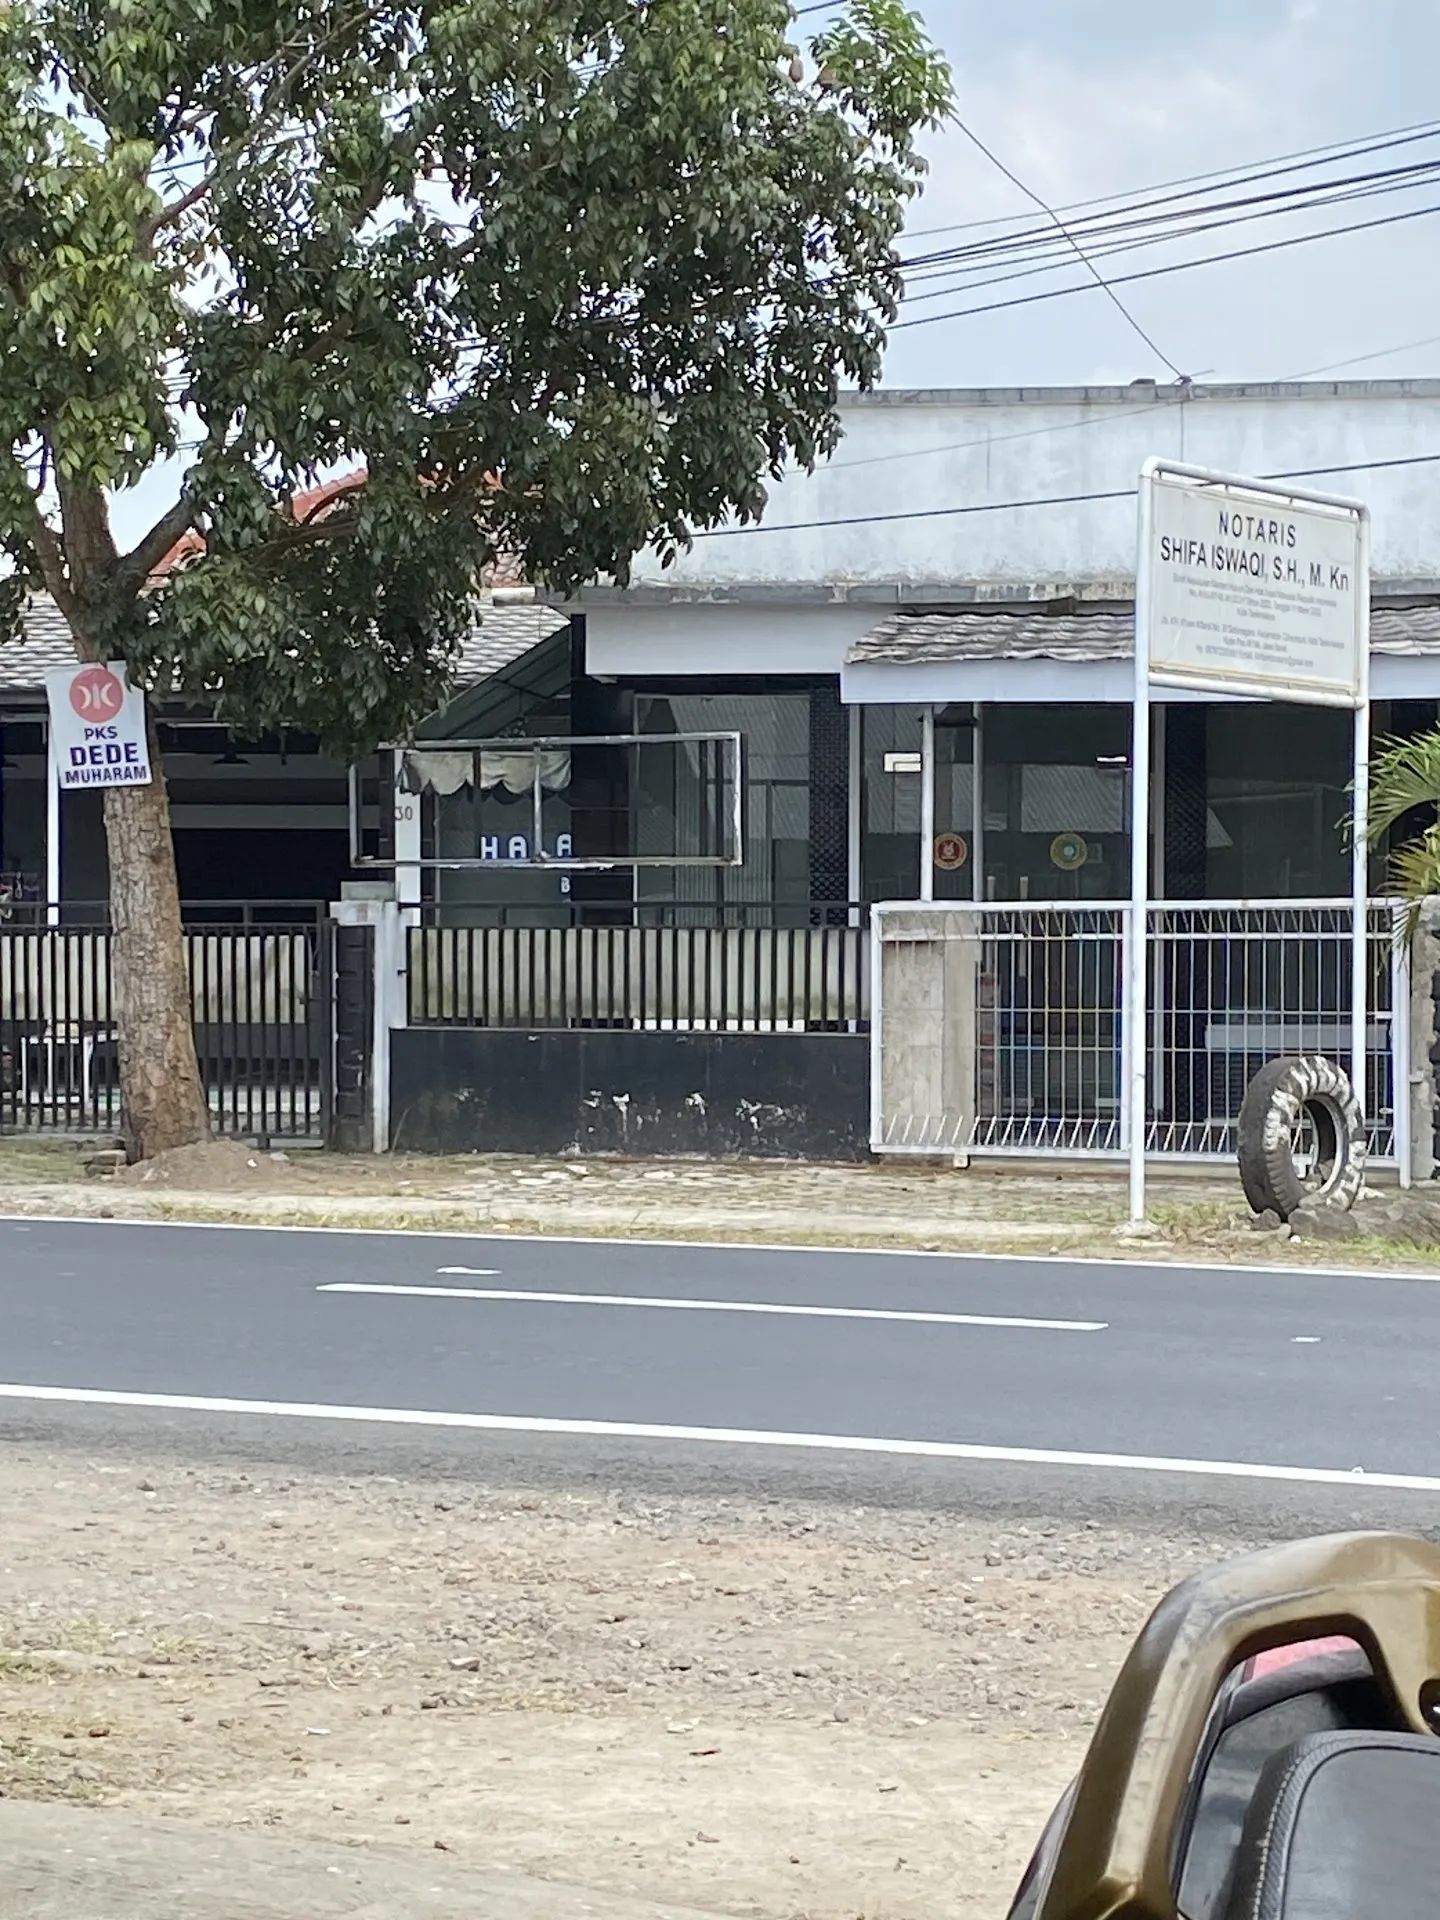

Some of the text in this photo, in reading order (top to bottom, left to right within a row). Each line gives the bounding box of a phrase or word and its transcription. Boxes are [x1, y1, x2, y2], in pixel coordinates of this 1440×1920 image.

[1219, 510, 1296, 548] NOTARIS
[1160, 536, 1207, 567] SHIFA
[1310, 562, 1326, 588] M.
[1330, 565, 1350, 592] Kn
[84, 726, 118, 741] PKS
[70, 742, 139, 767] DEDE
[65, 765, 148, 784] MUHARAM
